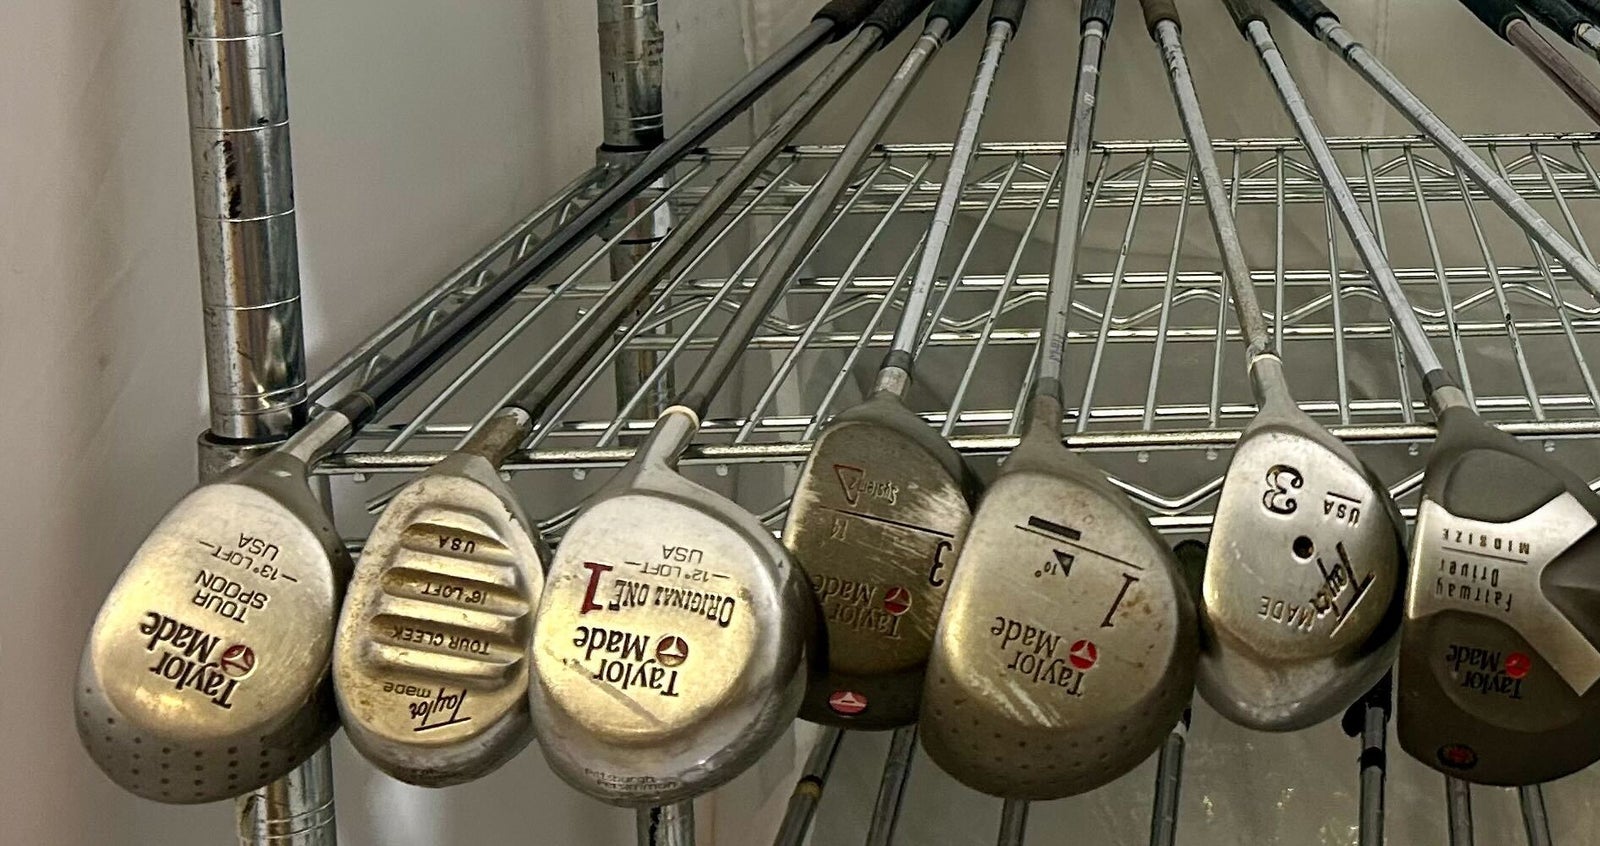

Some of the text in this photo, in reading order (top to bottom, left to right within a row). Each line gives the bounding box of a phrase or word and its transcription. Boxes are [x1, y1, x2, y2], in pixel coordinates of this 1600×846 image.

[1262, 465, 1304, 516] 3
[1323, 500, 1360, 527] USA
[238, 534, 279, 560] USA
[438, 535, 475, 554] USA
[662, 545, 703, 564] USA
[1441, 528, 1529, 555] MIDSIZE
[928, 540, 953, 588] 3
[1439, 559, 1499, 588] Driver
[191, 590, 248, 623] TOUR
[195, 570, 268, 609] SPOON
[422, 582, 464, 600] LOFT
[579, 562, 735, 628] ORIGINAL ONE 1
[812, 574, 877, 604] Made
[1101, 572, 1139, 629] 1
[1309, 541, 1376, 638] Taylor
[1435, 578, 1512, 612] Fairway
[827, 604, 901, 640] Taylor
[1257, 596, 1314, 632] MADE
[138, 612, 220, 658] Made
[391, 626, 491, 655] TOUR CLEEK
[573, 626, 650, 661] Made
[990, 616, 1061, 657] Made
[1008, 651, 1084, 699] Taylor
[1445, 644, 1501, 673] Made
[148, 653, 240, 709] Taylor
[592, 659, 680, 697] Taylor
[1460, 671, 1522, 699] Taylor
[408, 688, 471, 731] Taylor
